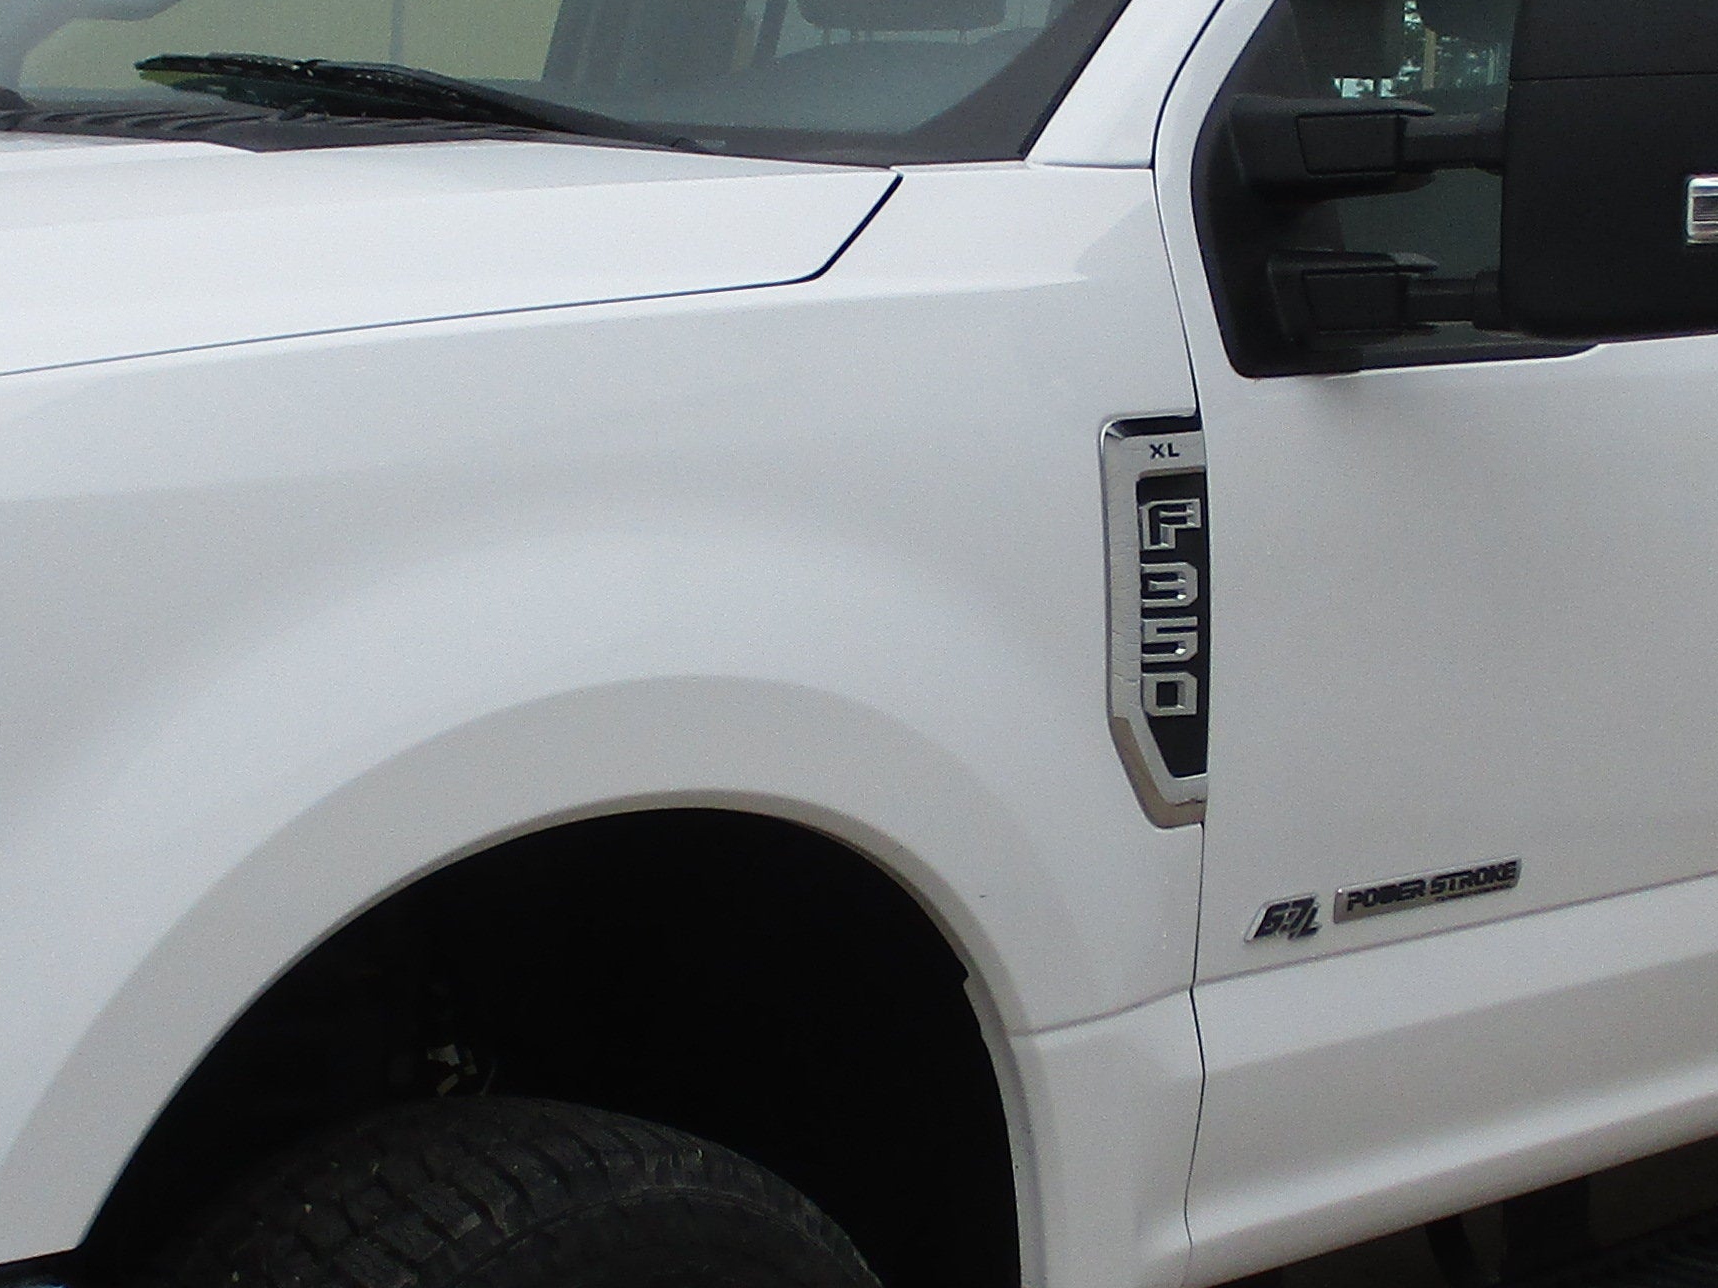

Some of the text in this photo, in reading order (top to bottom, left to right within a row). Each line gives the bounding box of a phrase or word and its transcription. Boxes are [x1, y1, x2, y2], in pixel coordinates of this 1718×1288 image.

[1149, 442, 1180, 461] XL
[1139, 498, 1202, 716] F350
[1346, 877, 1427, 913] POWER
[1428, 860, 1518, 895] STROKE
